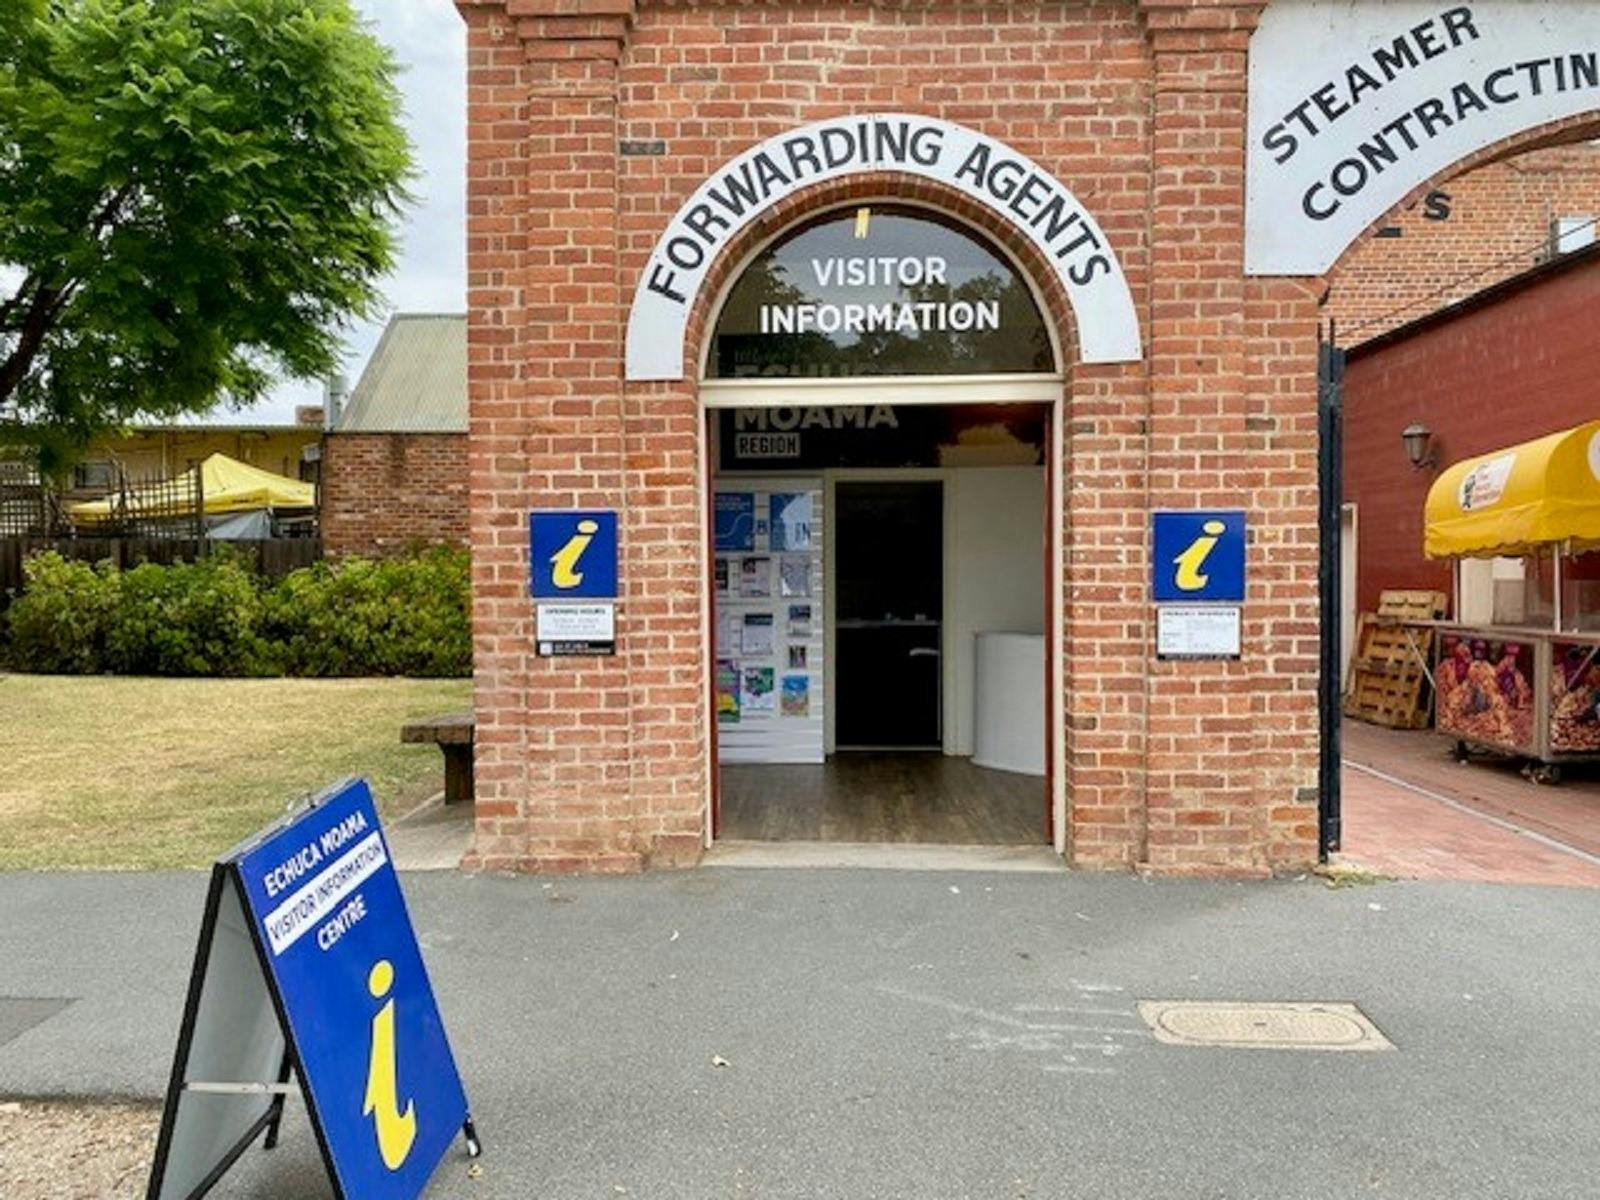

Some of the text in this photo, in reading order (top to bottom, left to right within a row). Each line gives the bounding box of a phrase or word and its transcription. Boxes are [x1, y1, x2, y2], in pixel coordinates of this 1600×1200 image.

[1261, 6, 1480, 166] STEAMER
[1302, 53, 1599, 221] CONTRACTIN
[646, 121, 1111, 306] FORWARDING AGENTS
[811, 256, 947, 287] VISITOR
[759, 300, 1001, 335] INFORMATION
[735, 405, 899, 431] MOAMA
[739, 435, 796, 455] REGION
[263, 809, 369, 898] ECHUCA MOAMA
[269, 841, 382, 943] VISITOR INFORMATION
[316, 893, 368, 952] CENTRE
